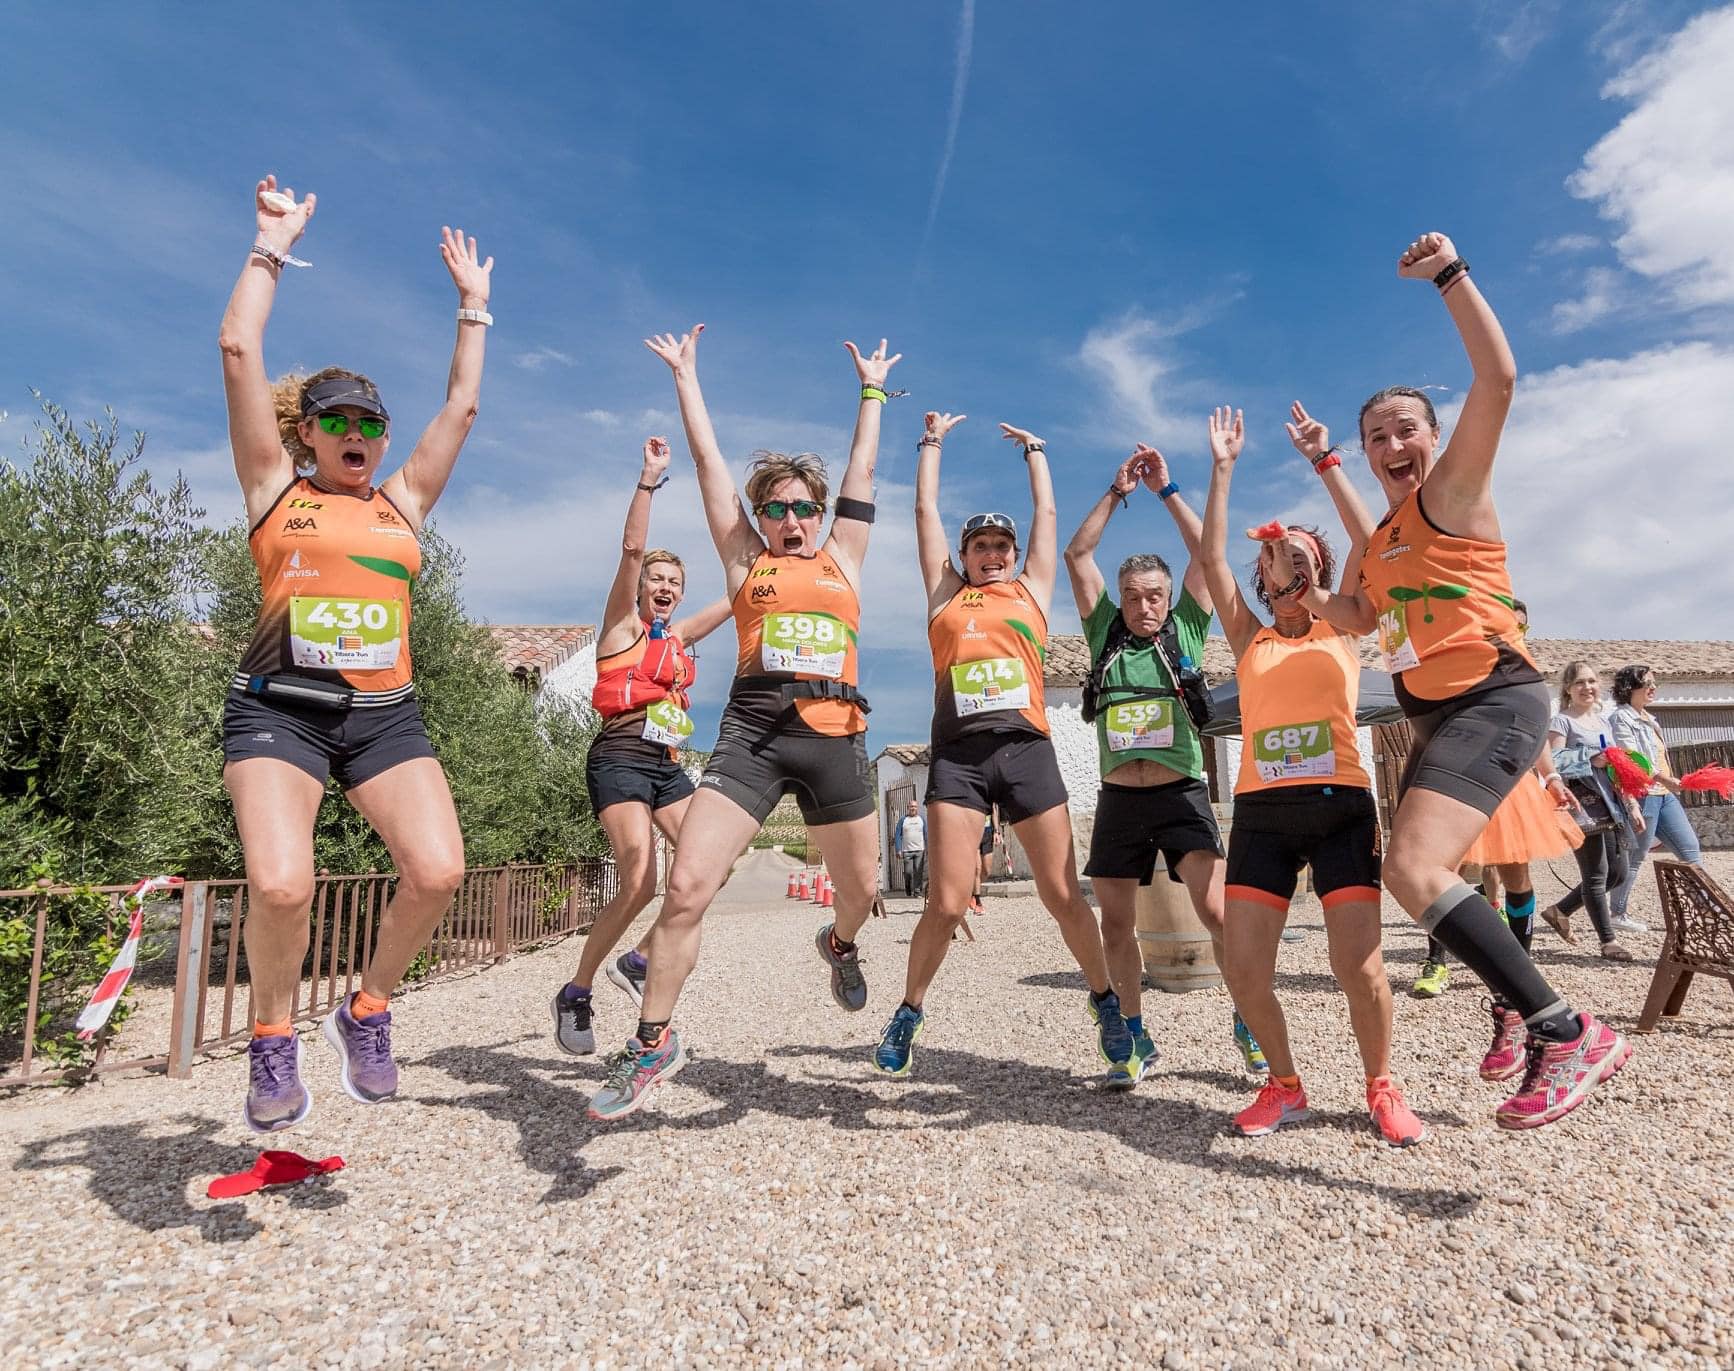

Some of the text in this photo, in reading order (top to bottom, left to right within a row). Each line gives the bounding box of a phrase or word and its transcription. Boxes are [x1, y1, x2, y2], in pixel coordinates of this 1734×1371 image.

[283, 517, 317, 532] A&A
[283, 570, 320, 579] URVISA
[751, 584, 777, 599] A&A
[307, 602, 388, 629] 430
[775, 616, 834, 642] 398
[966, 660, 1014, 683] 414
[657, 703, 687, 727] 431
[1117, 703, 1162, 724] 539
[1264, 725, 1319, 751] 687
